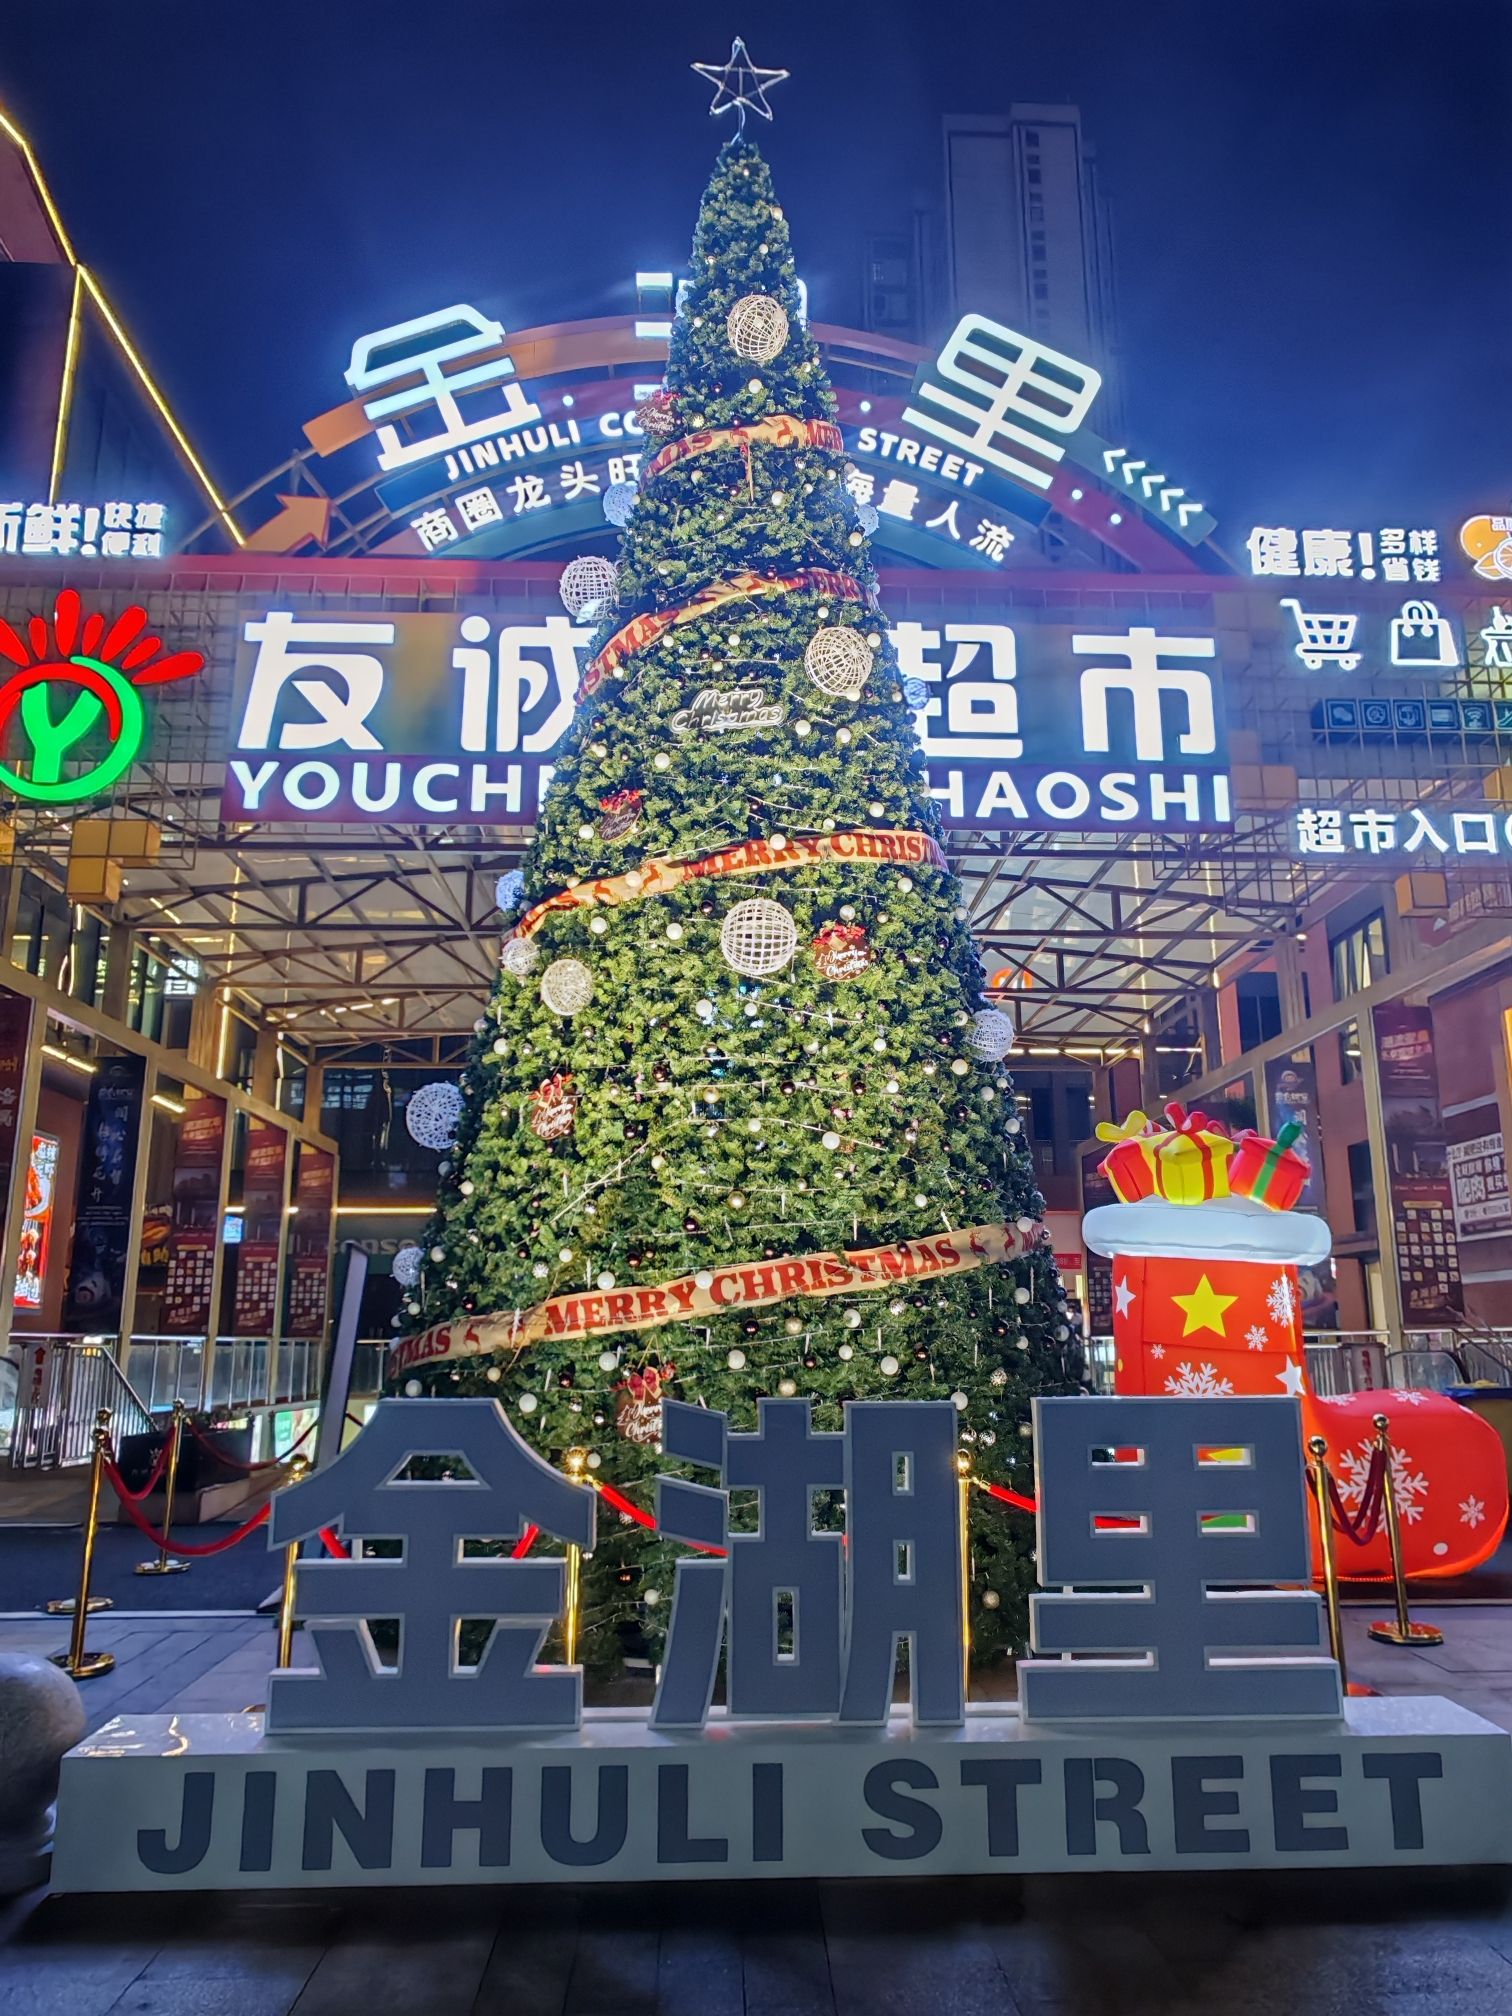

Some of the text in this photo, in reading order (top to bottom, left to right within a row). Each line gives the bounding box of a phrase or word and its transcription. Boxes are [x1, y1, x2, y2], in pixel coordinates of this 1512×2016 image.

[445, 419, 581, 481] JINHULI
[858, 427, 984, 487] STREET
[695, 689, 763, 709] Merry
[1297, 808, 1499, 854] 超市入口
[543, 1284, 695, 1336] MERRY
[709, 1238, 961, 1306] CHRISTMAS
[266, 1396, 1345, 1735] 金湖里
[136, 1752, 1443, 1876] JINHULI STREET
